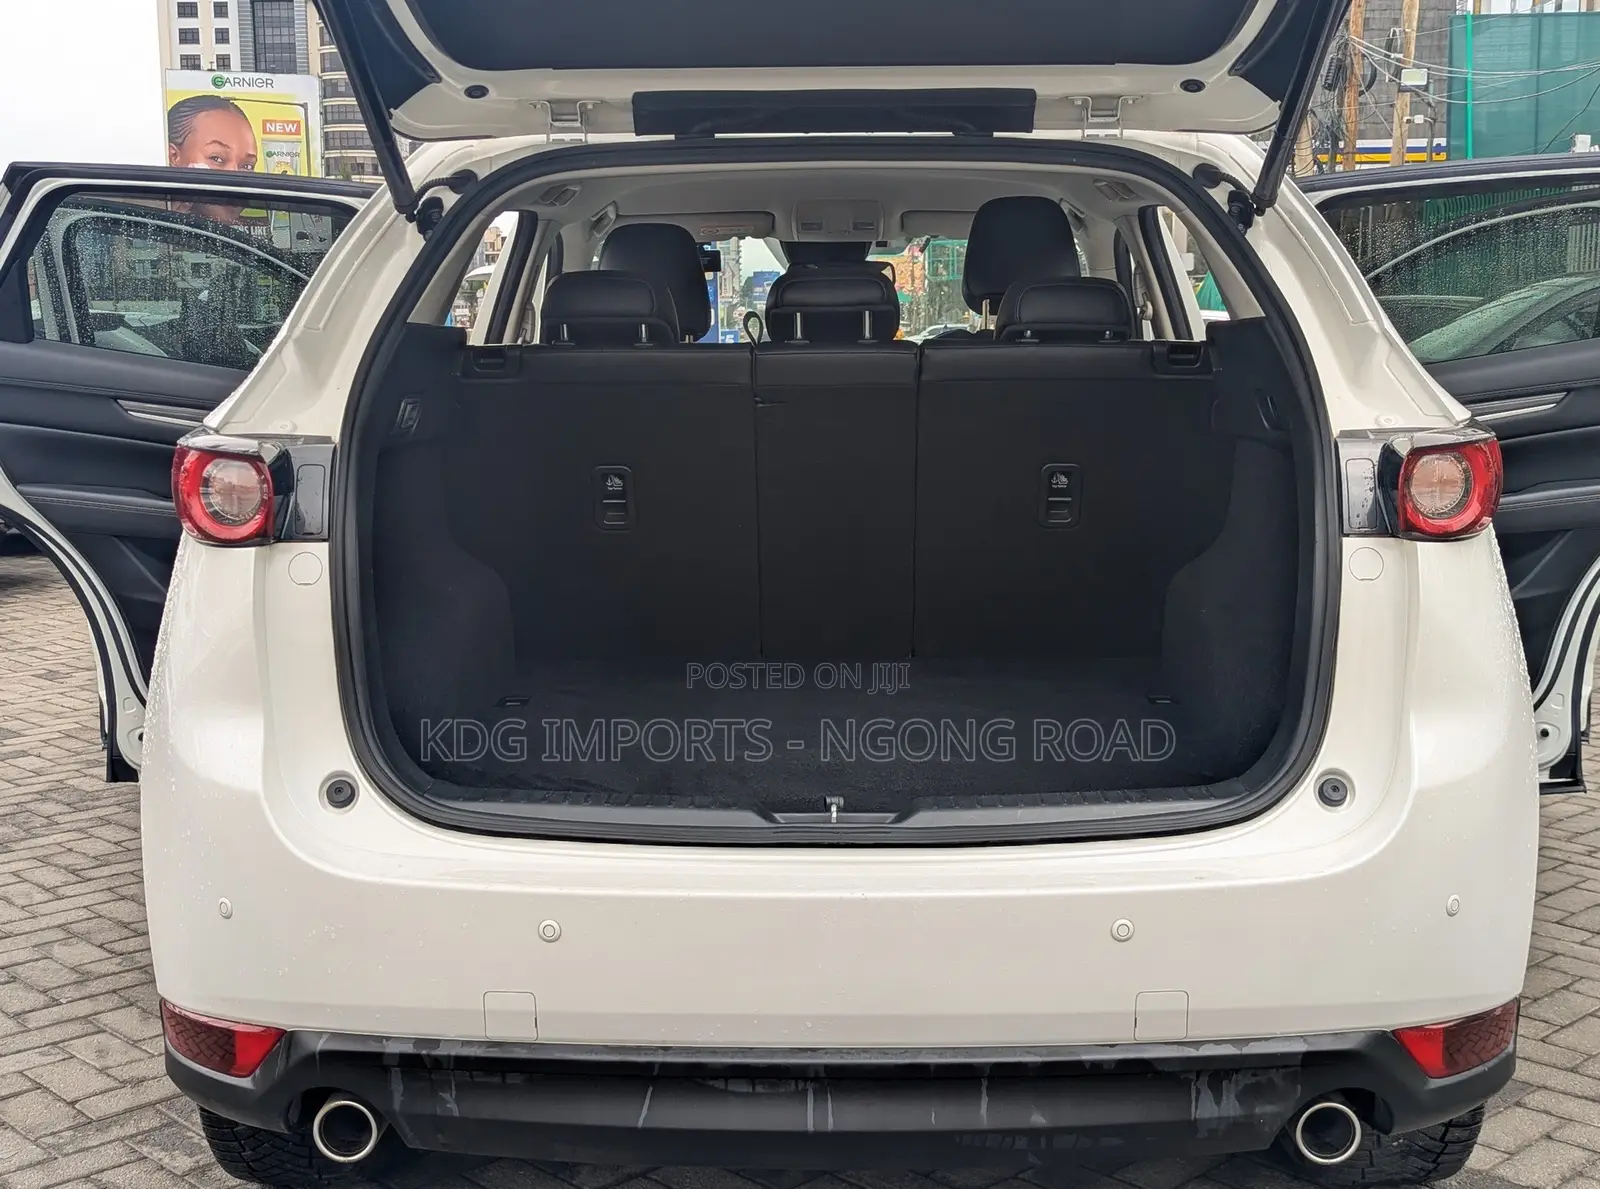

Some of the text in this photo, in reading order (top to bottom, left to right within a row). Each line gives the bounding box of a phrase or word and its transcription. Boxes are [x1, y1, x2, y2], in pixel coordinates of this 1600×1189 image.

[211, 74, 275, 89] GARNIER
[266, 122, 297, 133] NEW
[266, 150, 300, 158] GARNIER
